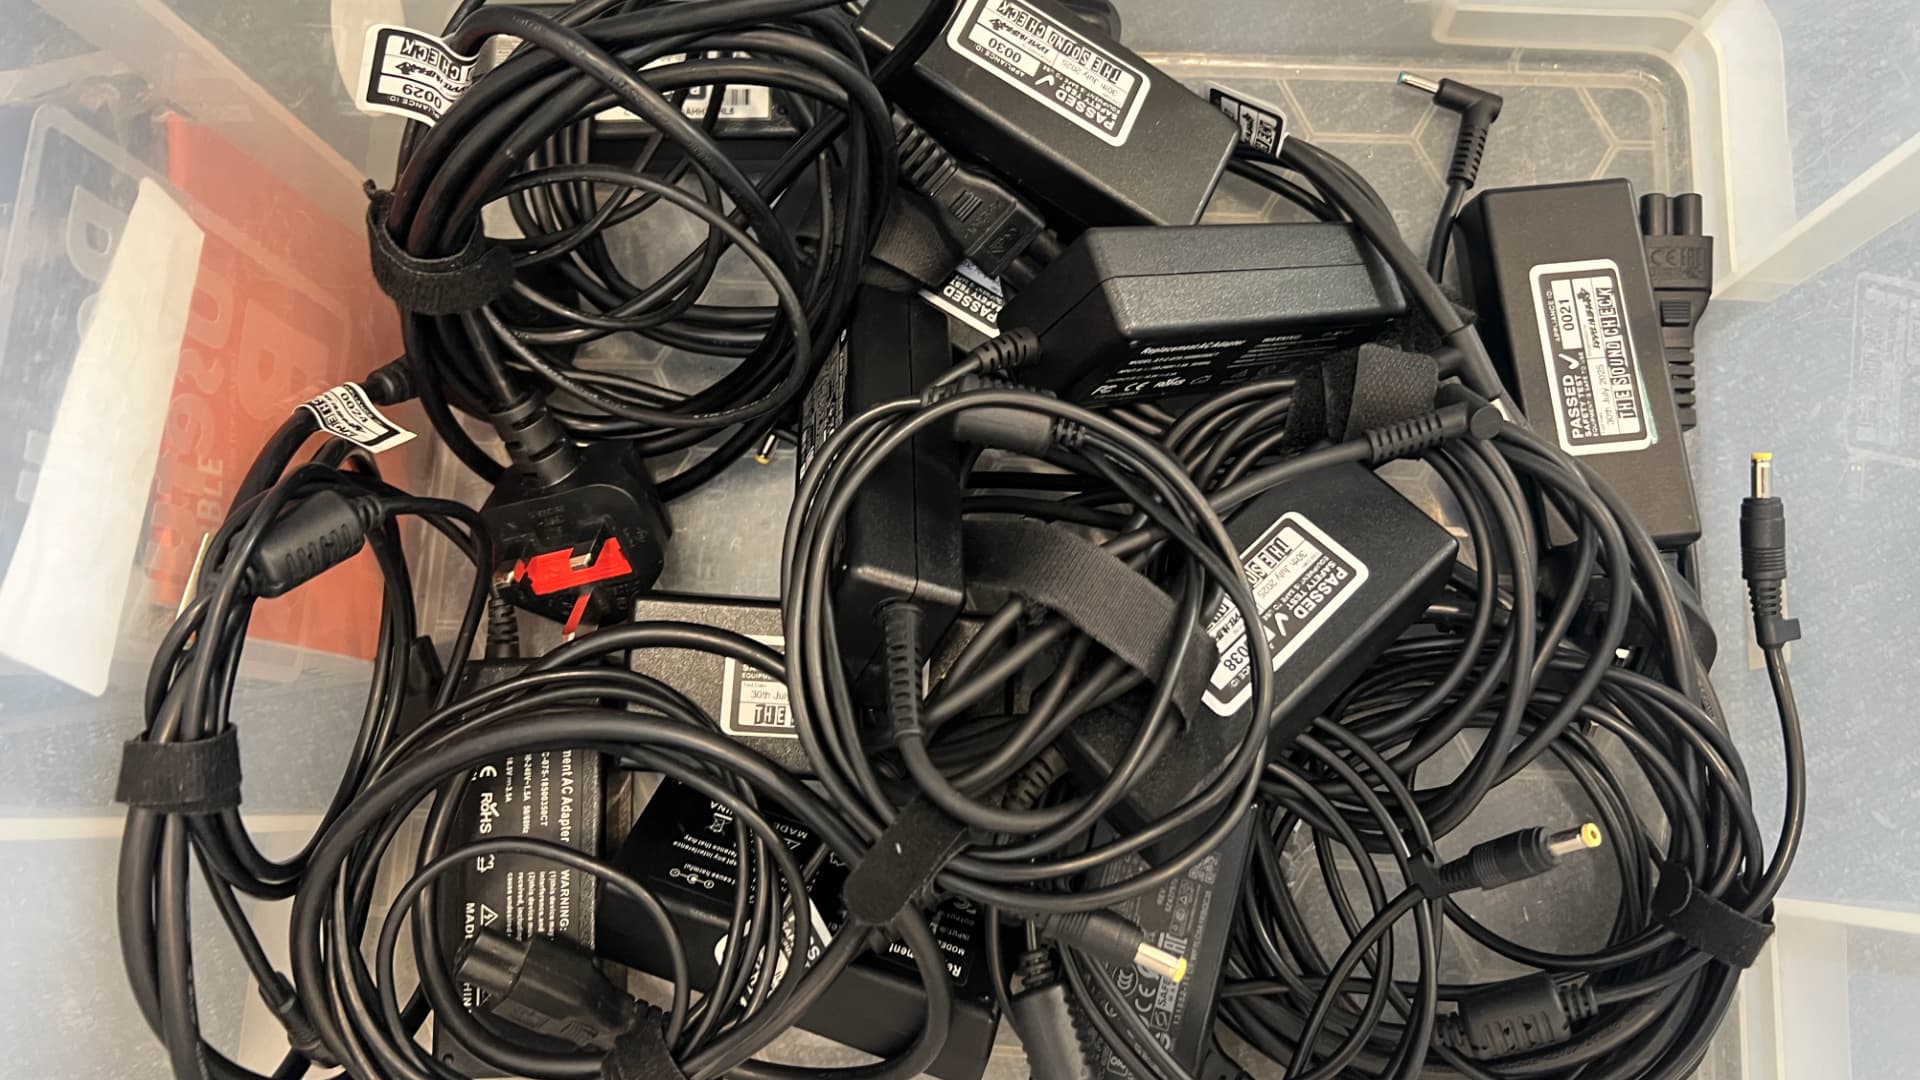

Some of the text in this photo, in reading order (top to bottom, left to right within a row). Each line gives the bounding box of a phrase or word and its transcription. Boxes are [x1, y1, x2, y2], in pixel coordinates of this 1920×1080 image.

[995, 0, 1049, 39] CHECK
[396, 37, 466, 81] CHECK
[983, 49, 1025, 77] APPLIANCE
[986, 36, 1023, 64] 0030
[1045, 30, 1091, 66] SOUND
[1081, 70, 1099, 85] July
[1089, 56, 1122, 84] THE
[400, 82, 444, 109] 0029
[1059, 81, 1082, 99] TEST
[1053, 87, 1116, 131] PASSED
[1082, 95, 1118, 120] SAFETY
[941, 283, 999, 323] PASSED
[949, 277, 1003, 312] SAFETY TEST
[1548, 300, 1560, 342] APPLIANCE
[1558, 297, 1574, 331] 0021
[1595, 285, 1635, 419] THE SOUND CHECK
[1596, 363, 1607, 385] 2025
[336, 390, 372, 424] 0024
[1562, 373, 1583, 439] PASSED
[1574, 373, 1592, 437] SAFETY TEST
[1600, 387, 1611, 404] July
[1257, 535, 1292, 570] THE
[1288, 548, 1308, 568] 30th
[1298, 553, 1329, 585] EQUIPMENT
[1255, 577, 1278, 599] 2025
[1272, 562, 1292, 582] July
[1304, 558, 1336, 591] SAFETY
[1279, 587, 1295, 603] SAFE
[1284, 588, 1307, 610] TEST
[1291, 564, 1348, 622] PASSED
[1221, 639, 1255, 673] 038
[750, 690, 787, 699] 30th Jul
[754, 704, 786, 725] THE
[561, 777, 573, 794] AC
[558, 796, 572, 842] Adapter
[559, 869, 569, 931] WARNING:
[464, 902, 474, 939] MAD
